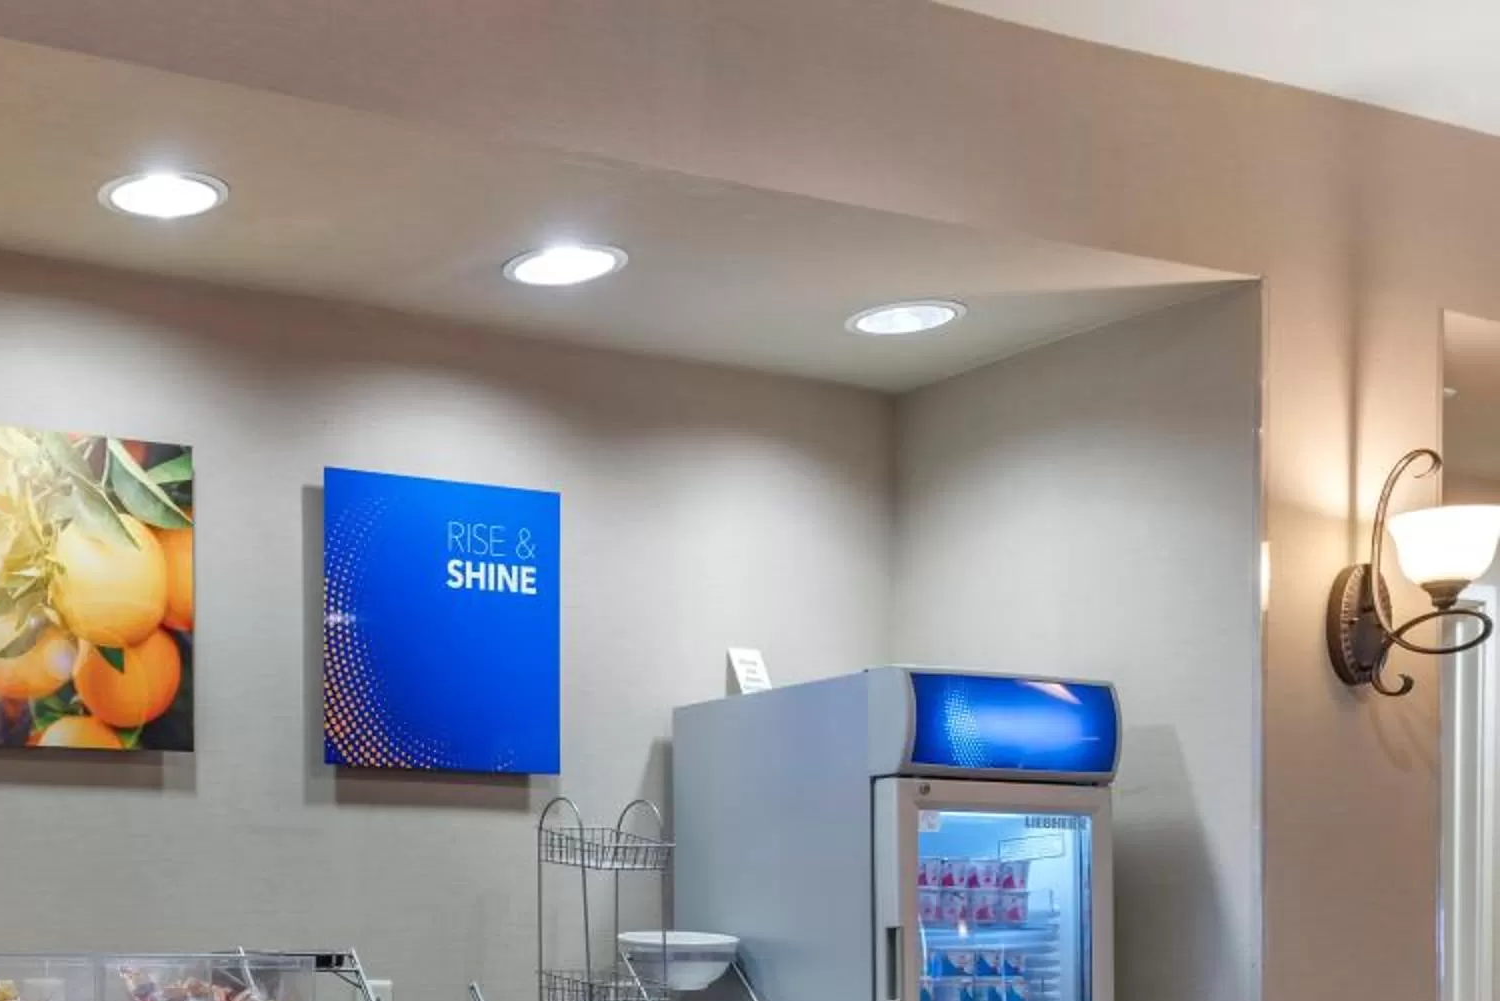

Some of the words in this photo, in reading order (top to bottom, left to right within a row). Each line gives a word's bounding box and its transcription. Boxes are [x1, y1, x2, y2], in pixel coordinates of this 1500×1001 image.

[447, 521, 506, 557] RISE
[515, 527, 536, 559] &
[446, 559, 537, 595] SHINE
